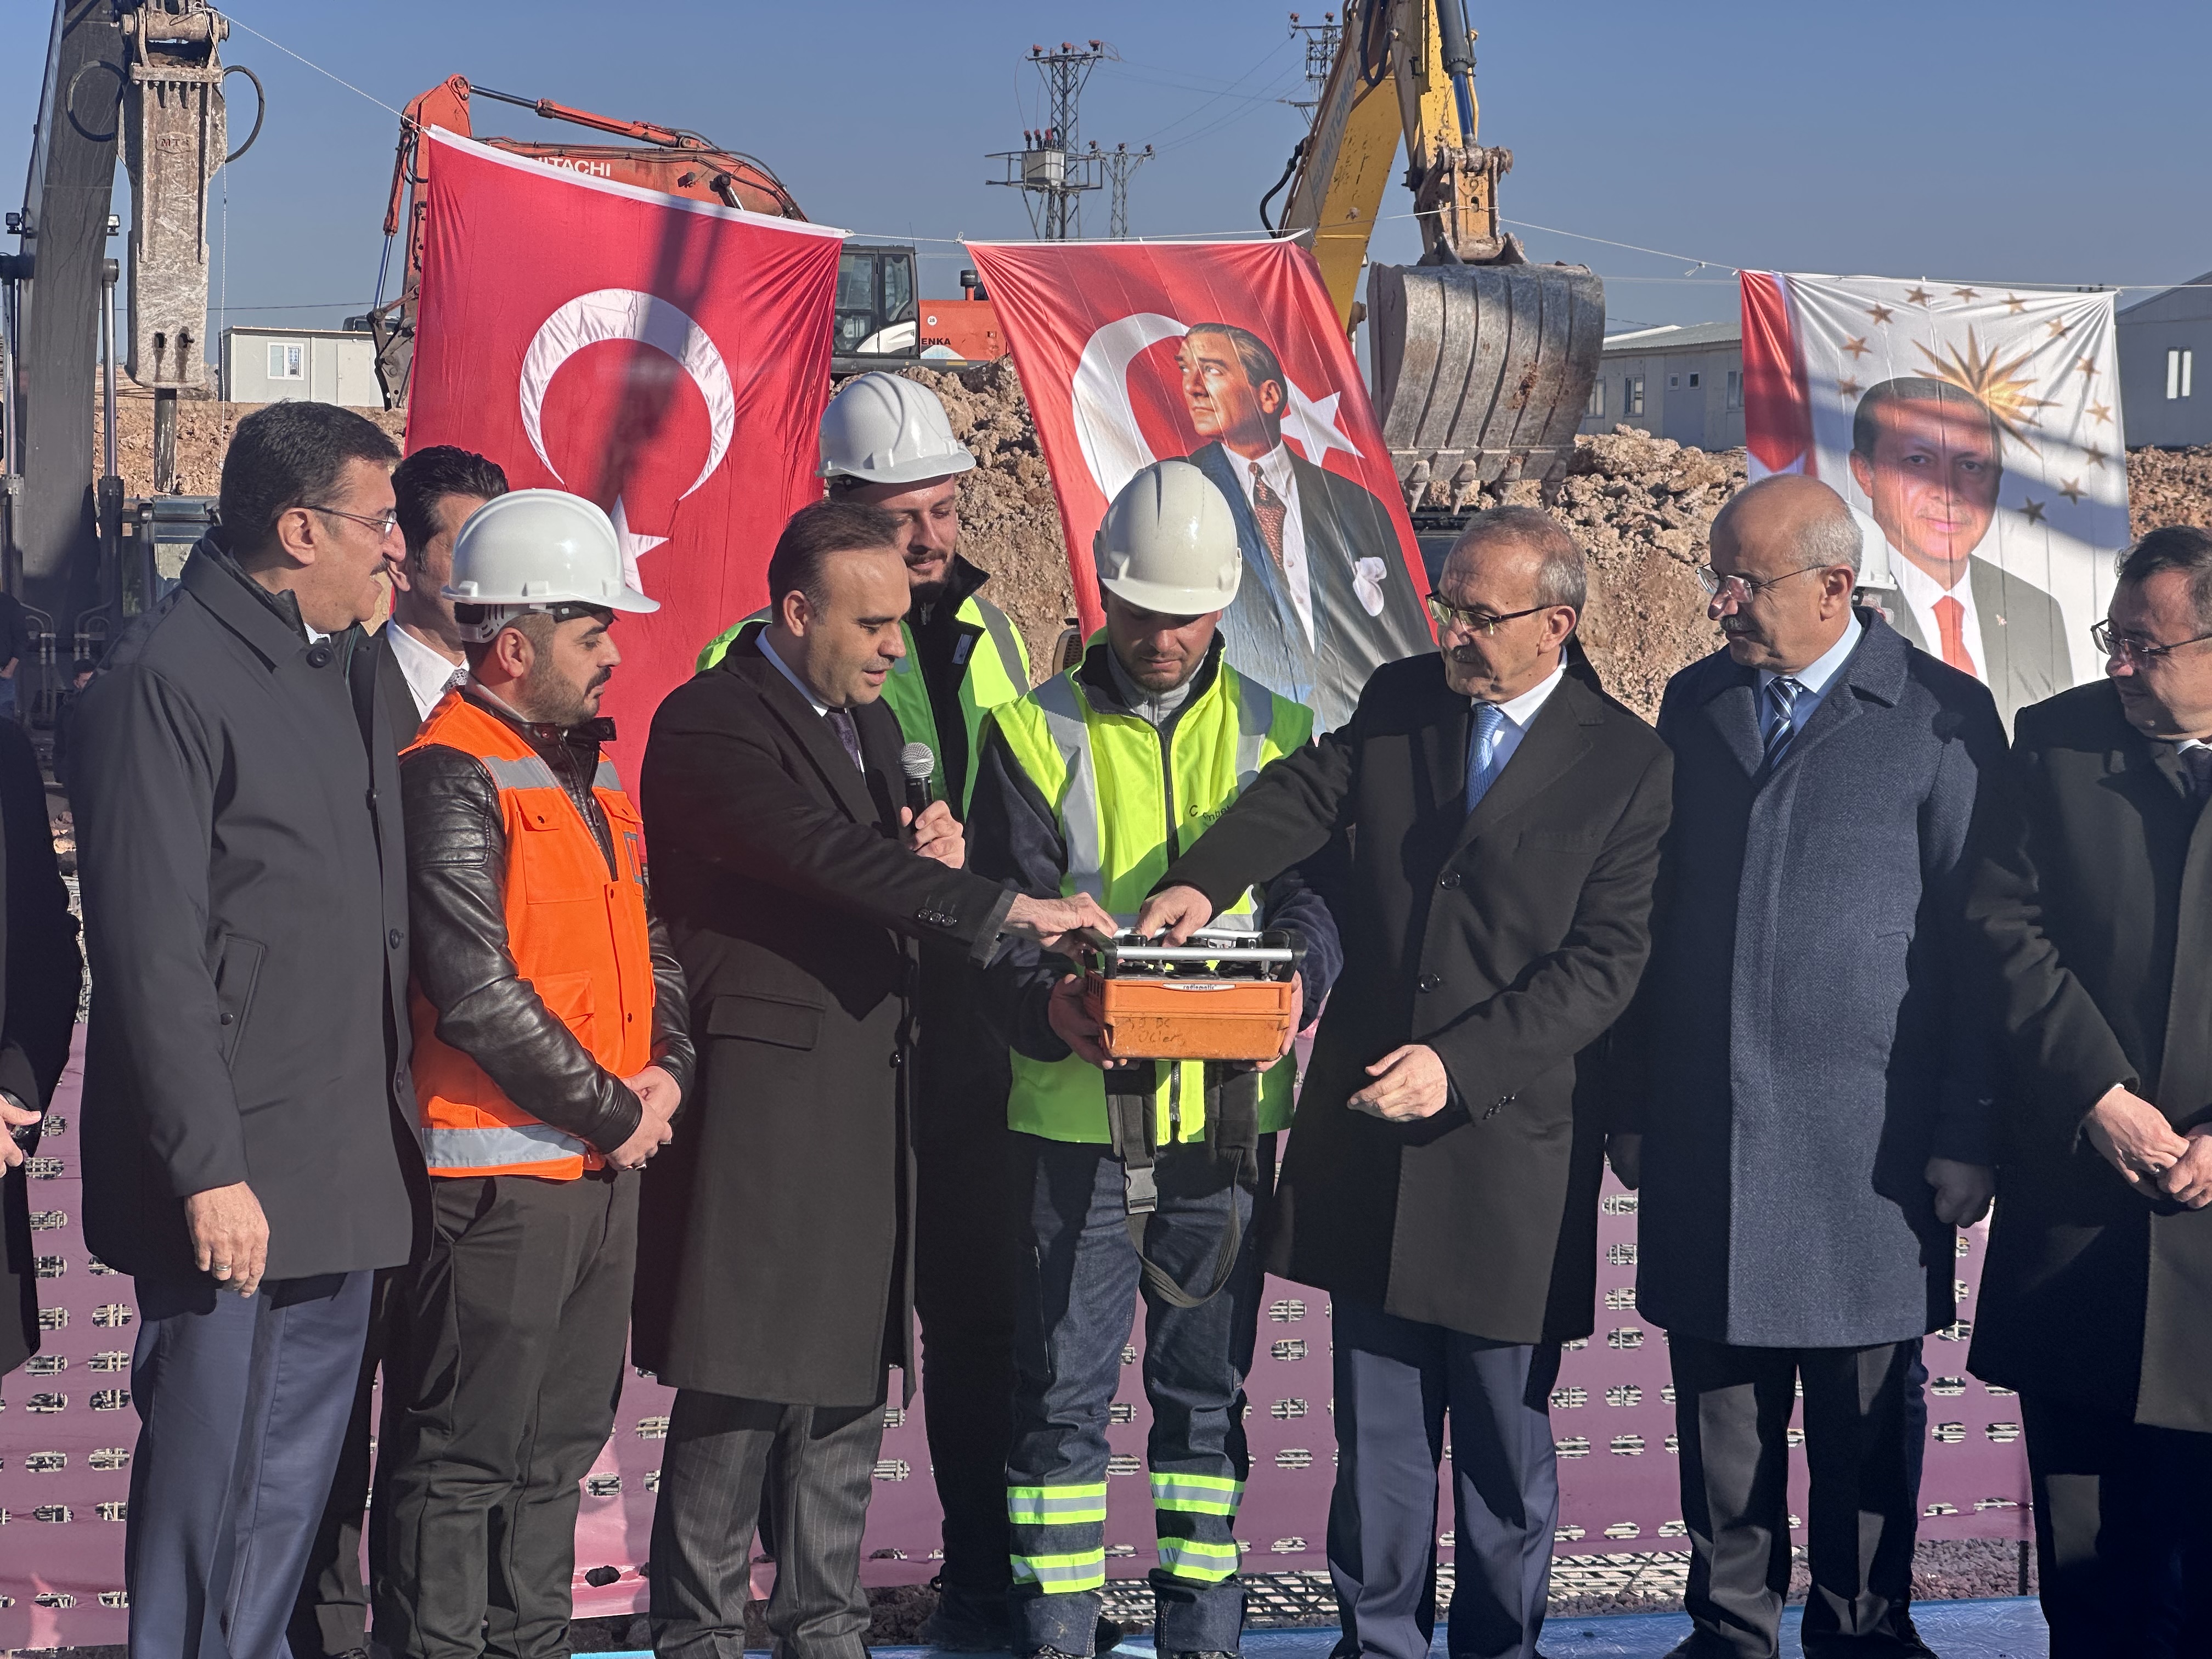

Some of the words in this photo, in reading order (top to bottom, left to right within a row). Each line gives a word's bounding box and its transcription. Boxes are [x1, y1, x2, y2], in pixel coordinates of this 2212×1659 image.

[42, 10, 62, 144] VOLVO
[1313, 64, 1355, 196] SUMITOMO
[537, 157, 611, 177] ITACHI
